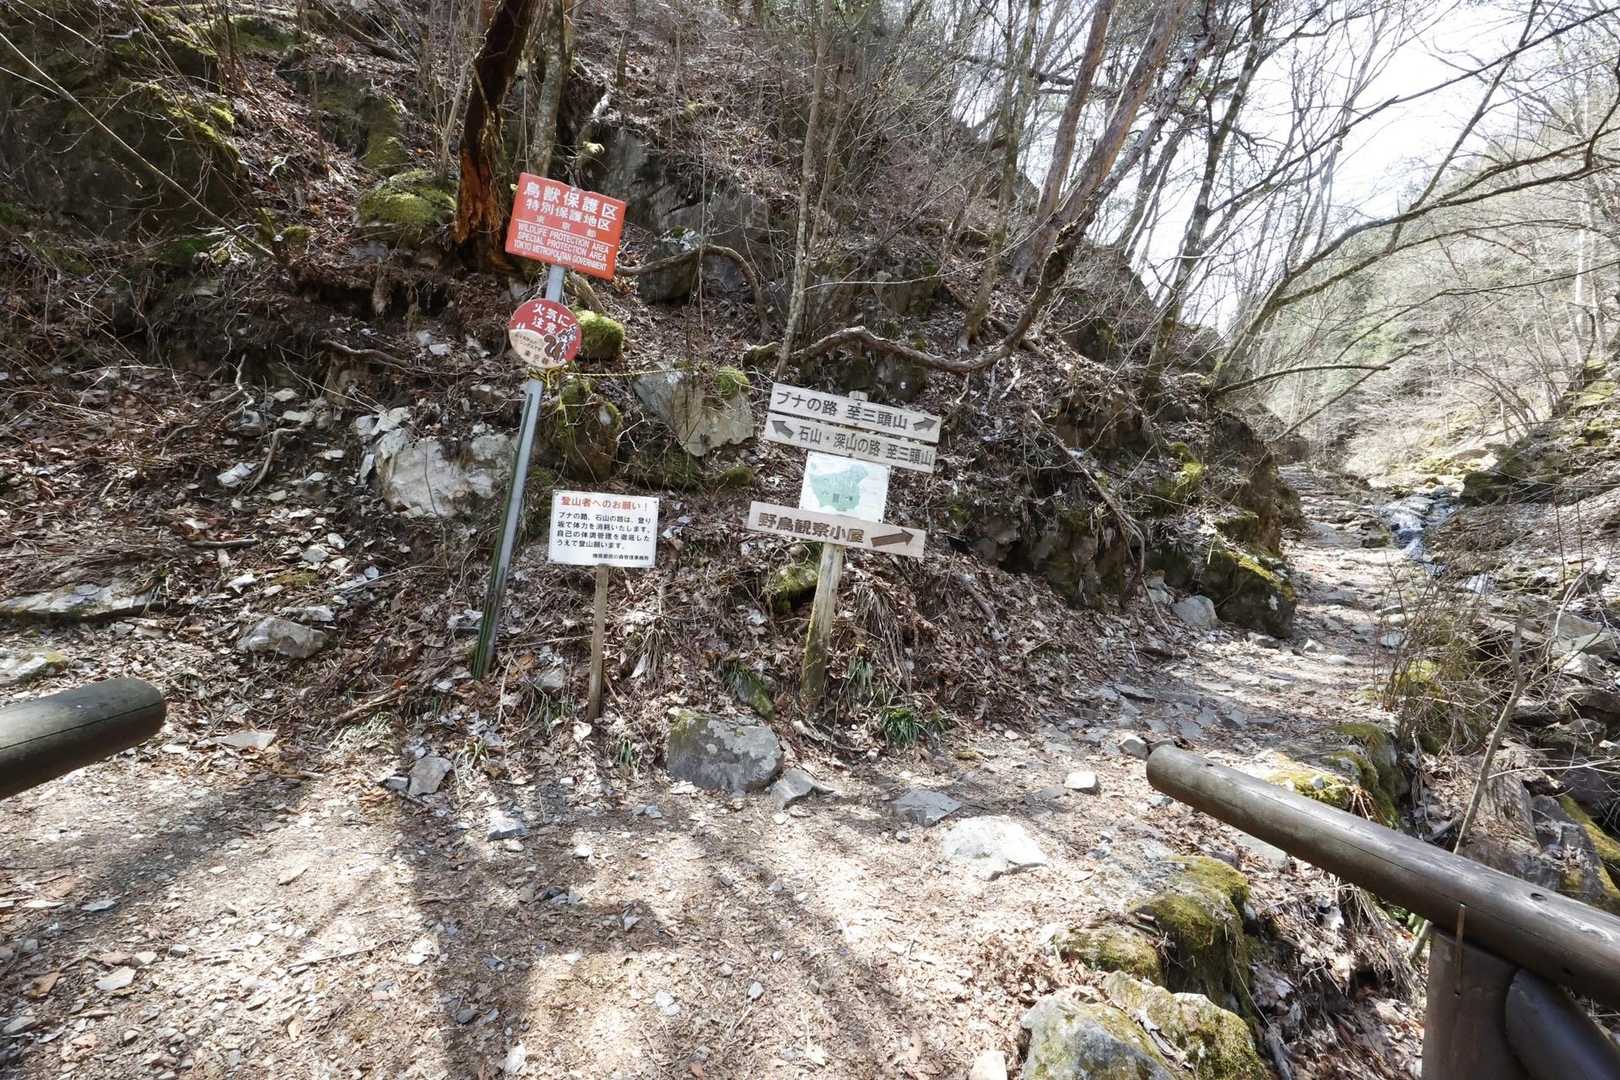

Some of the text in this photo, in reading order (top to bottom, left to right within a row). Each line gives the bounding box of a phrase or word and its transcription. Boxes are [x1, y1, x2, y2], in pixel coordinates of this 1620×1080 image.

[523, 182, 618, 219] 鳥獣保護区
[526, 199, 611, 231] 特別保護地区
[517, 231, 607, 262] SPECIAL PROTECTION AREA
[518, 223, 609, 254] WILDLIFE PROTECTION AREA
[531, 315, 557, 335] 注意
[532, 303, 571, 327] 火気に
[776, 391, 908, 430] ブナの路 至三頭山
[885, 443, 933, 466] 至三頭山
[560, 496, 648, 511] 登山者へのお願い！
[757, 512, 865, 544] 野鳥観察小屋
